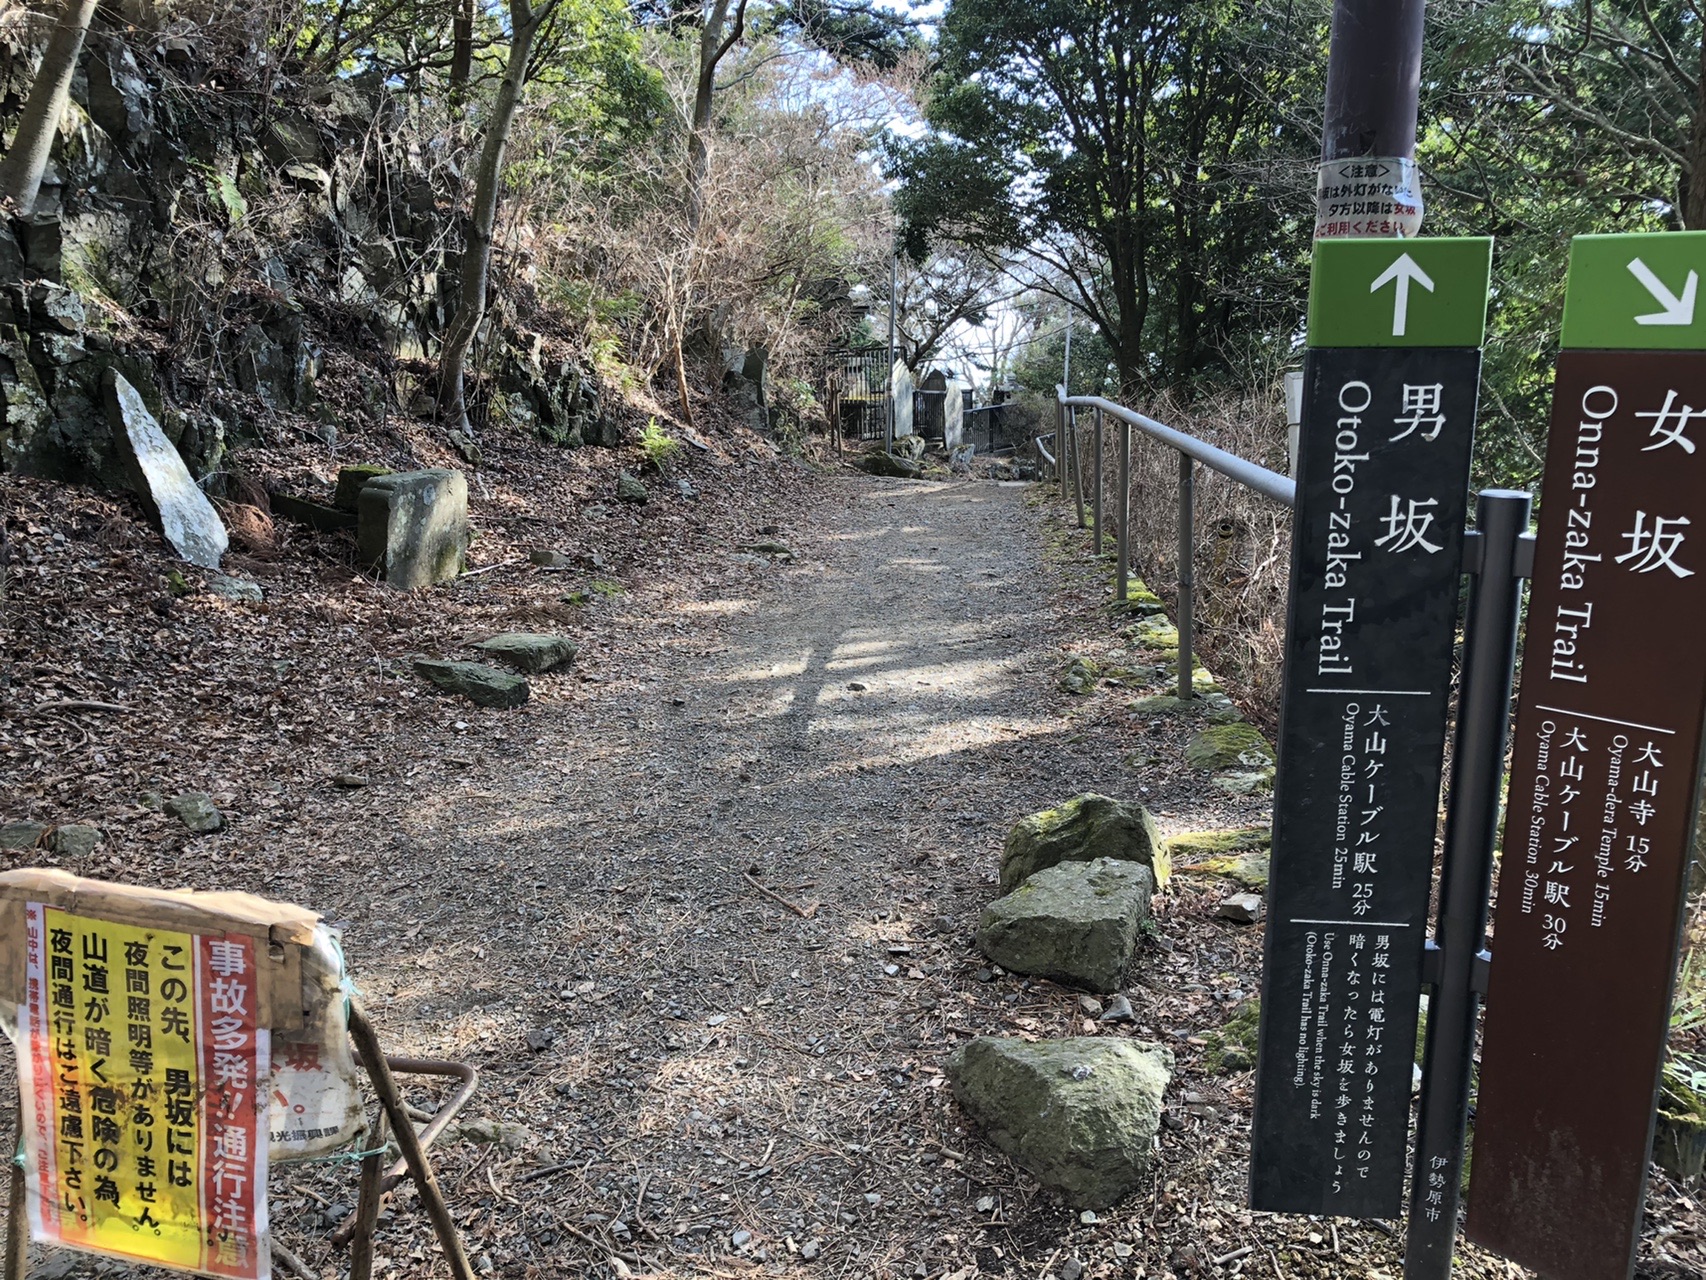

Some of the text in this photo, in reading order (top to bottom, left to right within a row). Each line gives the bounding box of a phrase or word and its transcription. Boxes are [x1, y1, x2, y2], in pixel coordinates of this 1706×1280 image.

[1318, 380, 1372, 676] Otoko-zaka Trail
[1374, 382, 1447, 555] 男坂
[1550, 385, 1619, 683] Onna-zaka Trail
[1614, 388, 1706, 579] 女坂
[1332, 702, 1360, 890] Oyama Cable Station 25min
[1351, 703, 1391, 916] 大山ケーブル駅 25分
[1521, 720, 1556, 914] Oyama Cable Station 30min
[1541, 726, 1589, 951] 大山ケーブル駅 30分
[1591, 734, 1629, 928] Oyama-dera Temple 15min
[1624, 741, 1664, 873] 大山寺 15分
[50, 928, 89, 1223] 夜間通行はご遠慮下さい。
[82, 932, 121, 1210] 山道が暗く危険の為、
[124, 940, 162, 1237] 夜間照明等がありません。
[1293, 931, 1318, 1089] (Otoko-zaka Trail has no lighting).
[1309, 932, 1335, 1119] Use Onna-zaka Trail when the sky is dark
[1332, 933, 1366, 1194] 暗くなったら女坂を歩きましょう
[1356, 934, 1391, 1179] 男坂には電灯がありませんので
[163, 1067, 194, 1188] 男坂には
[1425, 1155, 1448, 1223] 伊勢原市
